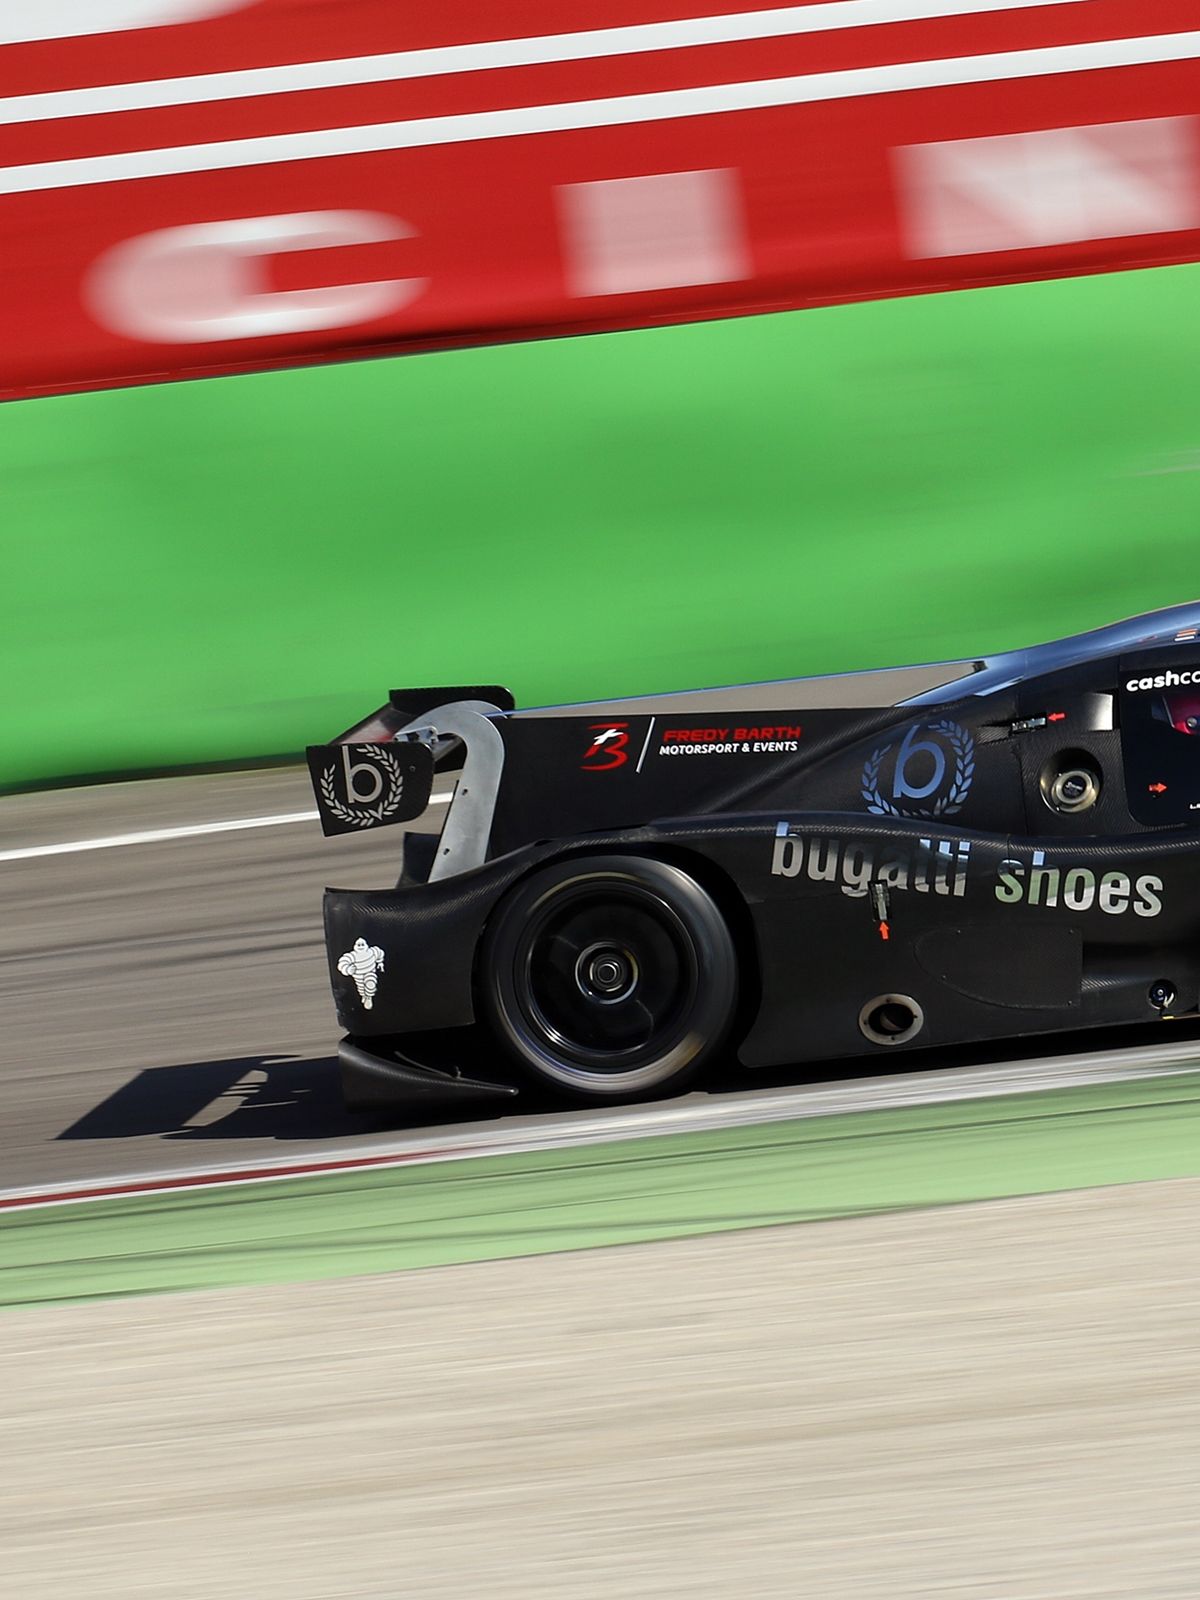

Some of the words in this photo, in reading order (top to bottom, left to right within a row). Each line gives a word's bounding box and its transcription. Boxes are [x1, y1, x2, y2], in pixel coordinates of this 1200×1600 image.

[663, 729, 728, 742] FREDY
[733, 727, 802, 740] BARTH
[659, 743, 739, 756] MOTORSPORT
[743, 743, 750, 753] &
[753, 741, 798, 753] EVENTS
[771, 821, 971, 897] bugatti
[995, 851, 1163, 917] shoes
